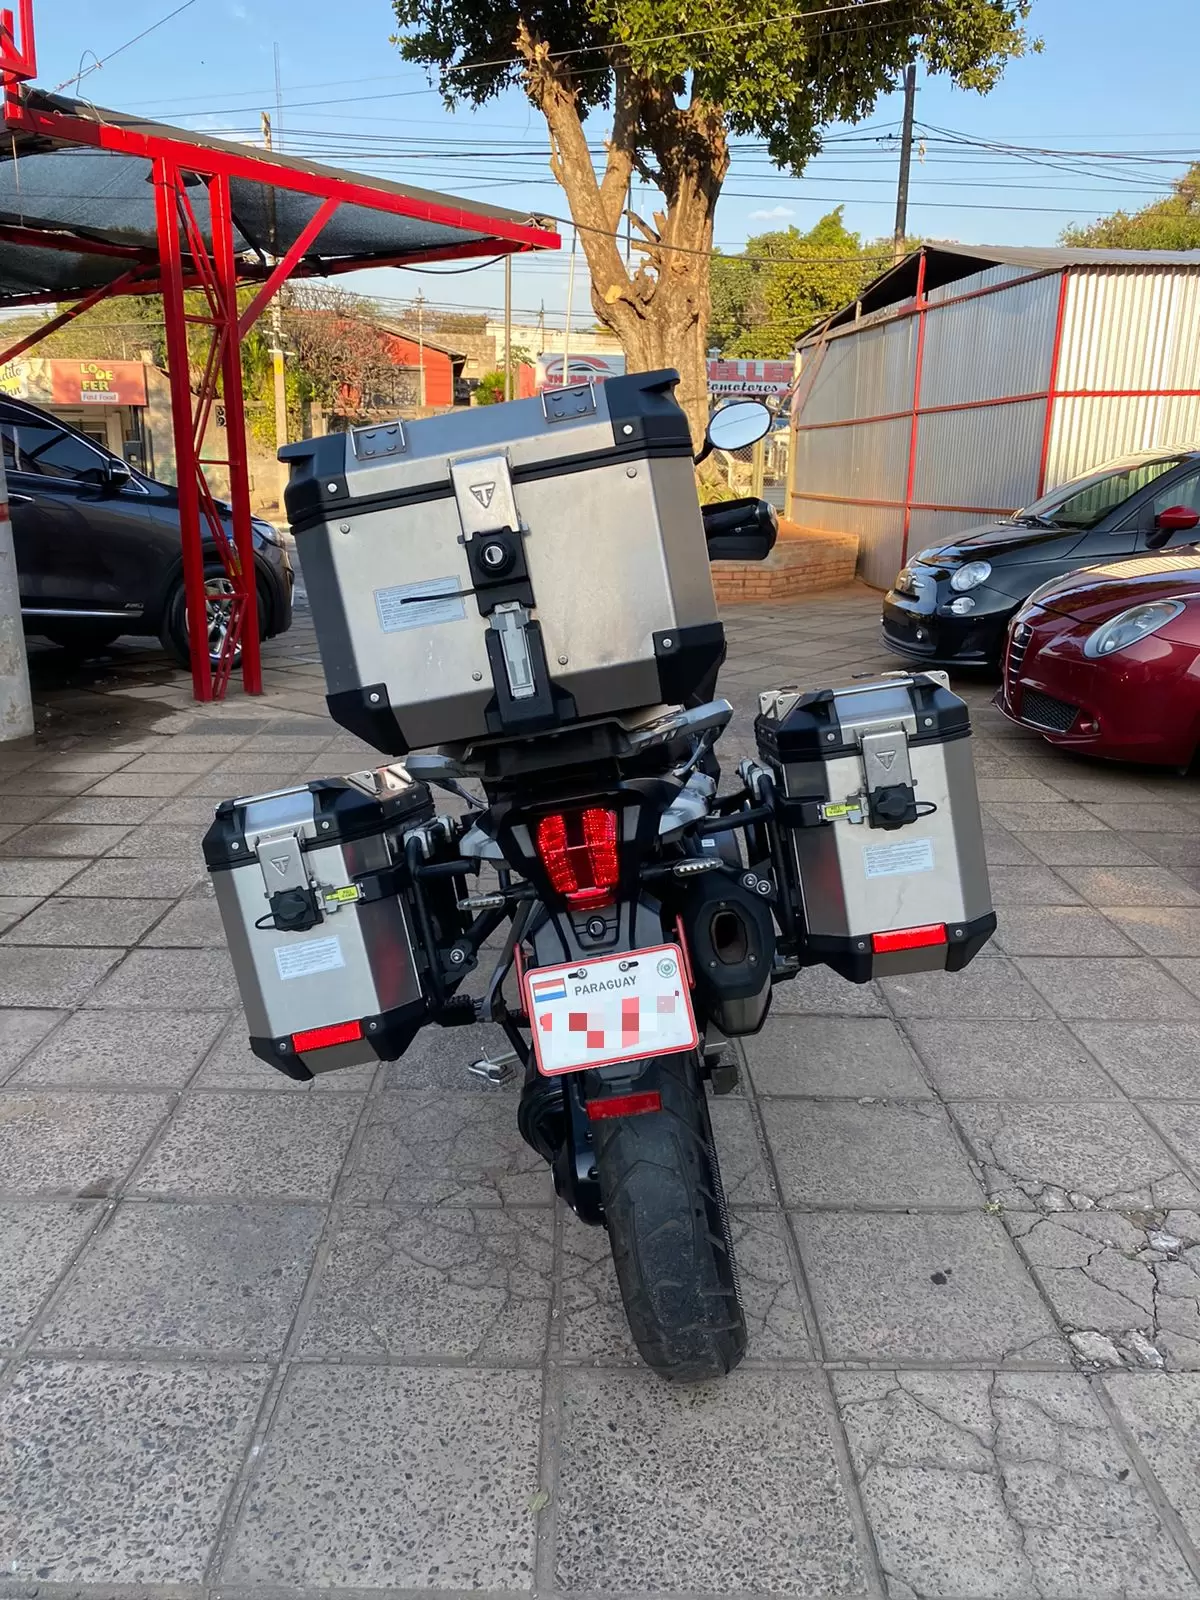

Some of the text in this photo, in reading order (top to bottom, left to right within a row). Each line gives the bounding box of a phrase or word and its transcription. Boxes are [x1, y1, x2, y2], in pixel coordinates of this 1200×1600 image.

[80, 362, 113, 381] LO DE
[81, 380, 110, 392] FER
[82, 393, 117, 401] Fast Food
[574, 975, 638, 997] PARAGUAY
